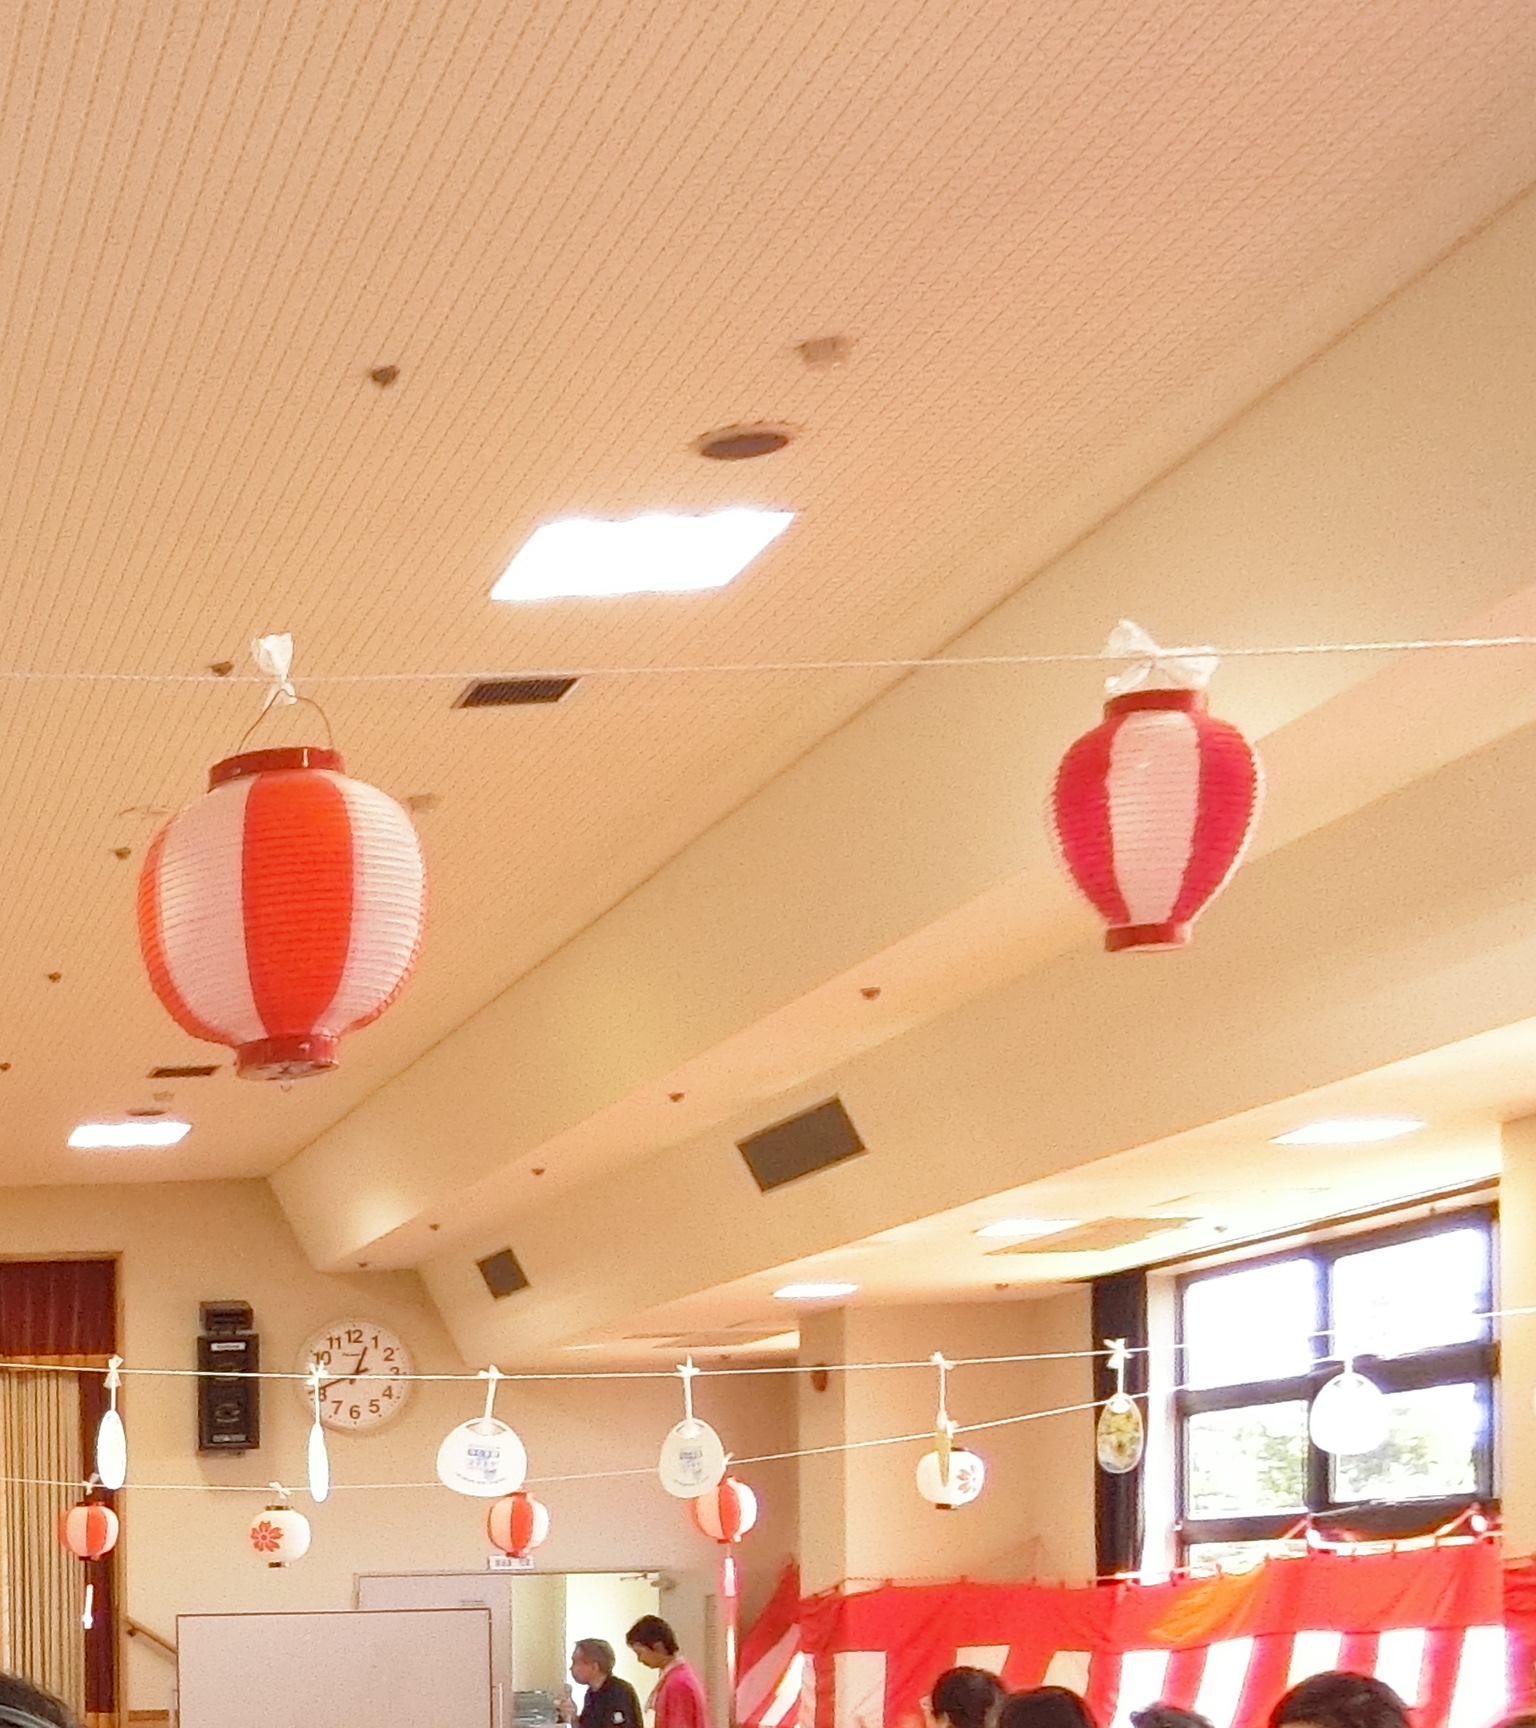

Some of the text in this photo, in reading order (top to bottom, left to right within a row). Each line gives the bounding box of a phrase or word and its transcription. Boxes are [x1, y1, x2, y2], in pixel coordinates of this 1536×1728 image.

[326, 1336, 341, 1350] 11
[345, 1329, 363, 1343] 12
[371, 1335, 378, 1349] 1
[313, 1350, 332, 1366] 10
[383, 1347, 395, 1362] 2
[382, 1385, 393, 1399] 4
[331, 1400, 343, 1415] 7
[349, 1405, 361, 1419] 6
[369, 1399, 380, 1414] 5
